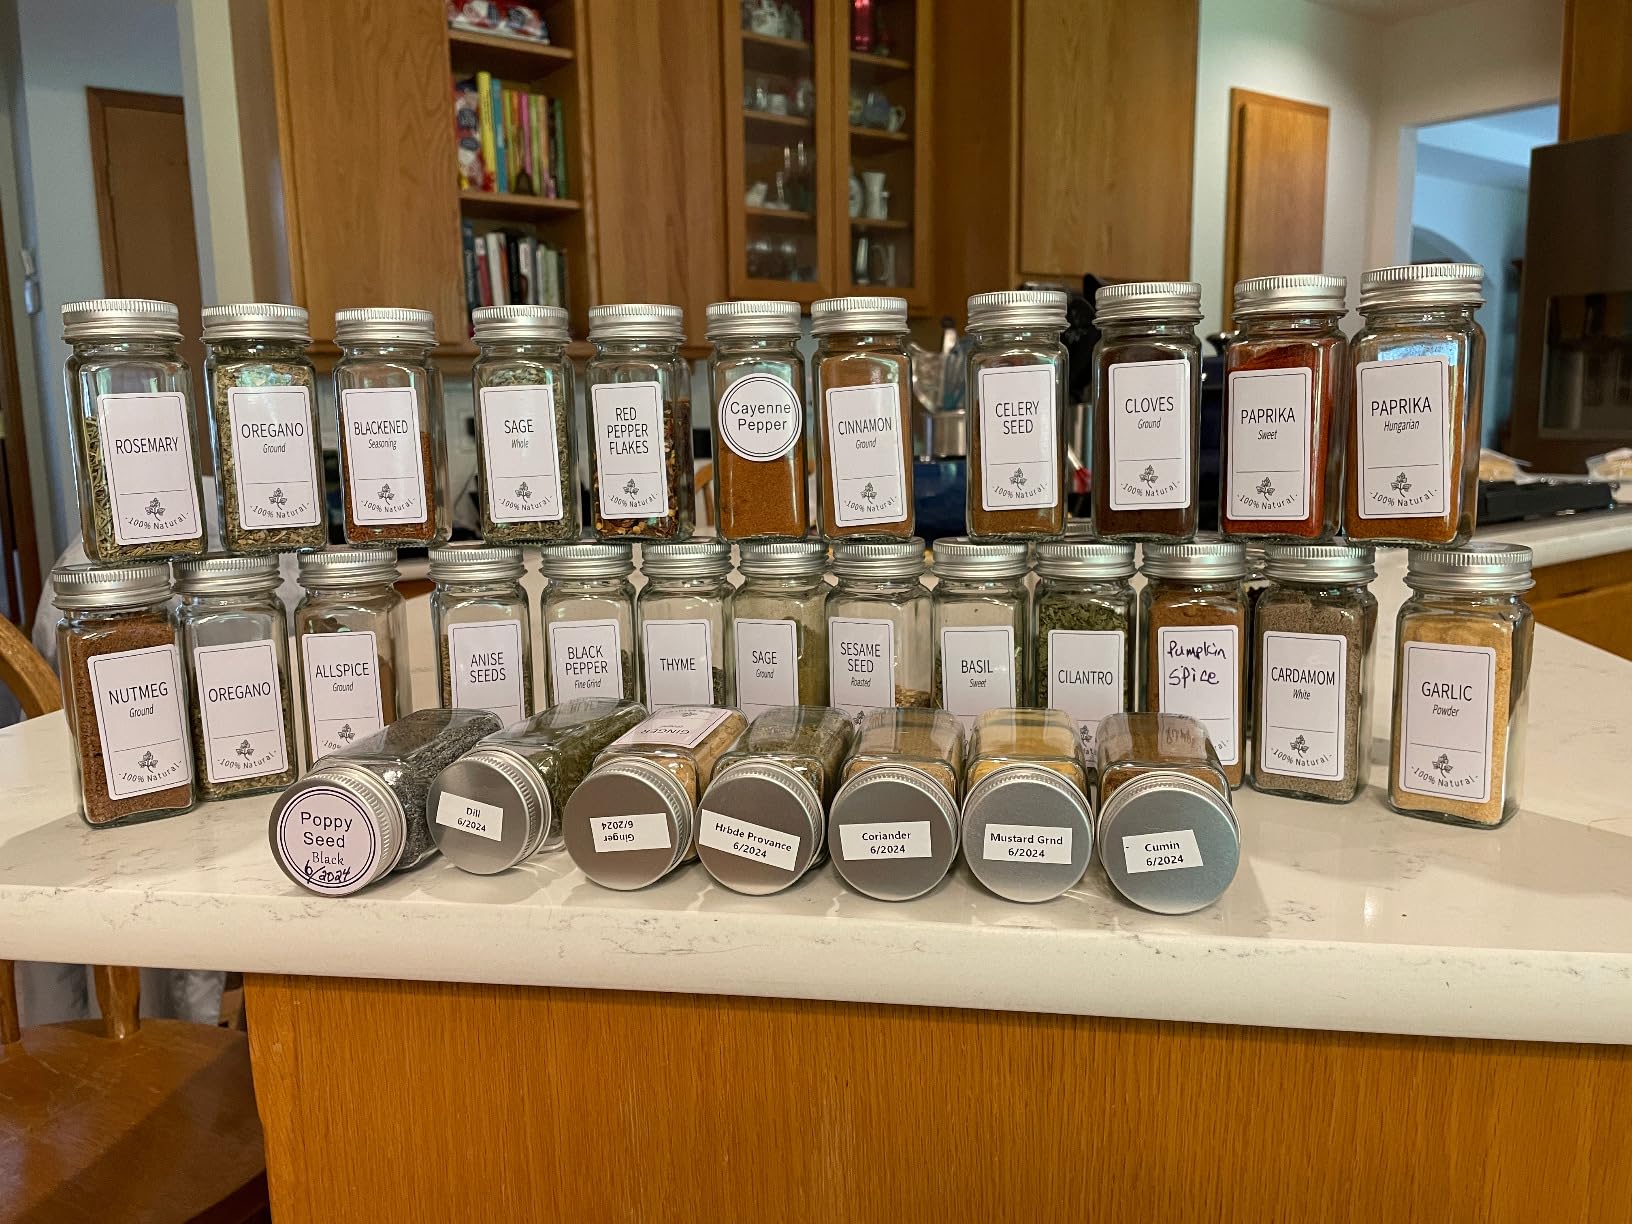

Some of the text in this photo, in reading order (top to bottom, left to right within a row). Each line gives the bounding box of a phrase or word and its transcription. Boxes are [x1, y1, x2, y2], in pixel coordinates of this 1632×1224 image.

[731, 402, 791, 417] Cayenne
[996, 401, 1039, 417] CELERY
[1125, 397, 1174, 413] CLOVES
[1371, 397, 1431, 416] PAPRIKA
[616, 407, 636, 421] RED
[1241, 408, 1295, 424] PAPRIKA
[354, 420, 408, 435] BLACKENED
[505, 419, 534, 433] SAGE
[738, 419, 787, 433] Pepper
[838, 417, 892, 435] CINNAMON
[1003, 420, 1033, 434] SEED
[1138, 417, 1161, 429] Ground
[1384, 419, 1419, 433] Hungarian
[242, 423, 303, 438] OREGANO
[607, 424, 648, 438] PEPPER
[1258, 430, 1277, 440] Sweet
[116, 437, 178, 454] ROSEMARY
[263, 443, 285, 453] Ground
[368, 439, 397, 450] Seasoning
[511, 440, 528, 448] Whole
[610, 441, 649, 454] FLAKES
[856, 438, 876, 449] Ground
[568, 646, 603, 659] BLACK
[841, 642, 881, 657] SESAME
[1167, 640, 1226, 659] Pumpkin
[471, 652, 504, 667] ANISE
[660, 658, 696, 671] THYME
[752, 651, 777, 665] SAGE
[316, 663, 369, 678] ALLSPICE
[566, 661, 608, 675] PEPPER
[848, 659, 873, 673] SEED
[961, 660, 993, 674] BASIL
[470, 668, 506, 683] SEEDS
[756, 669, 773, 678] Ground
[1058, 670, 1113, 685] CILANTRO
[1271, 667, 1335, 685] CARDAMOM
[333, 682, 353, 692] Ground
[575, 678, 601, 689] Fine Grind
[851, 677, 871, 688] Roasted
[970, 679, 986, 687] Sweet
[109, 682, 168, 704] NUTMEG
[208, 682, 271, 702] OREGANO
[1293, 689, 1310, 700] White
[1422, 682, 1472, 701] GARLIC
[130, 704, 154, 718] Ground
[1433, 704, 1459, 717] Powder
[466, 808, 480, 818] Dill
[301, 812, 352, 831] Poppy
[458, 817, 486, 832] 6/2024
[602, 821, 633, 829] 6/2024
[304, 833, 345, 848] Seed
[604, 833, 634, 841] Ginger
[747, 831, 792, 852] Provance
[862, 831, 911, 841] Coriander
[990, 833, 1063, 845] Mustard Grnd
[733, 842, 766, 859] 6/2024
[870, 845, 905, 854] 6/2024
[1008, 848, 1044, 858] 6/2024
[1145, 842, 1180, 852] Cumin
[312, 851, 344, 865] Black
[1146, 855, 1184, 866] 6/2024
[305, 860, 350, 884] 6/2024
